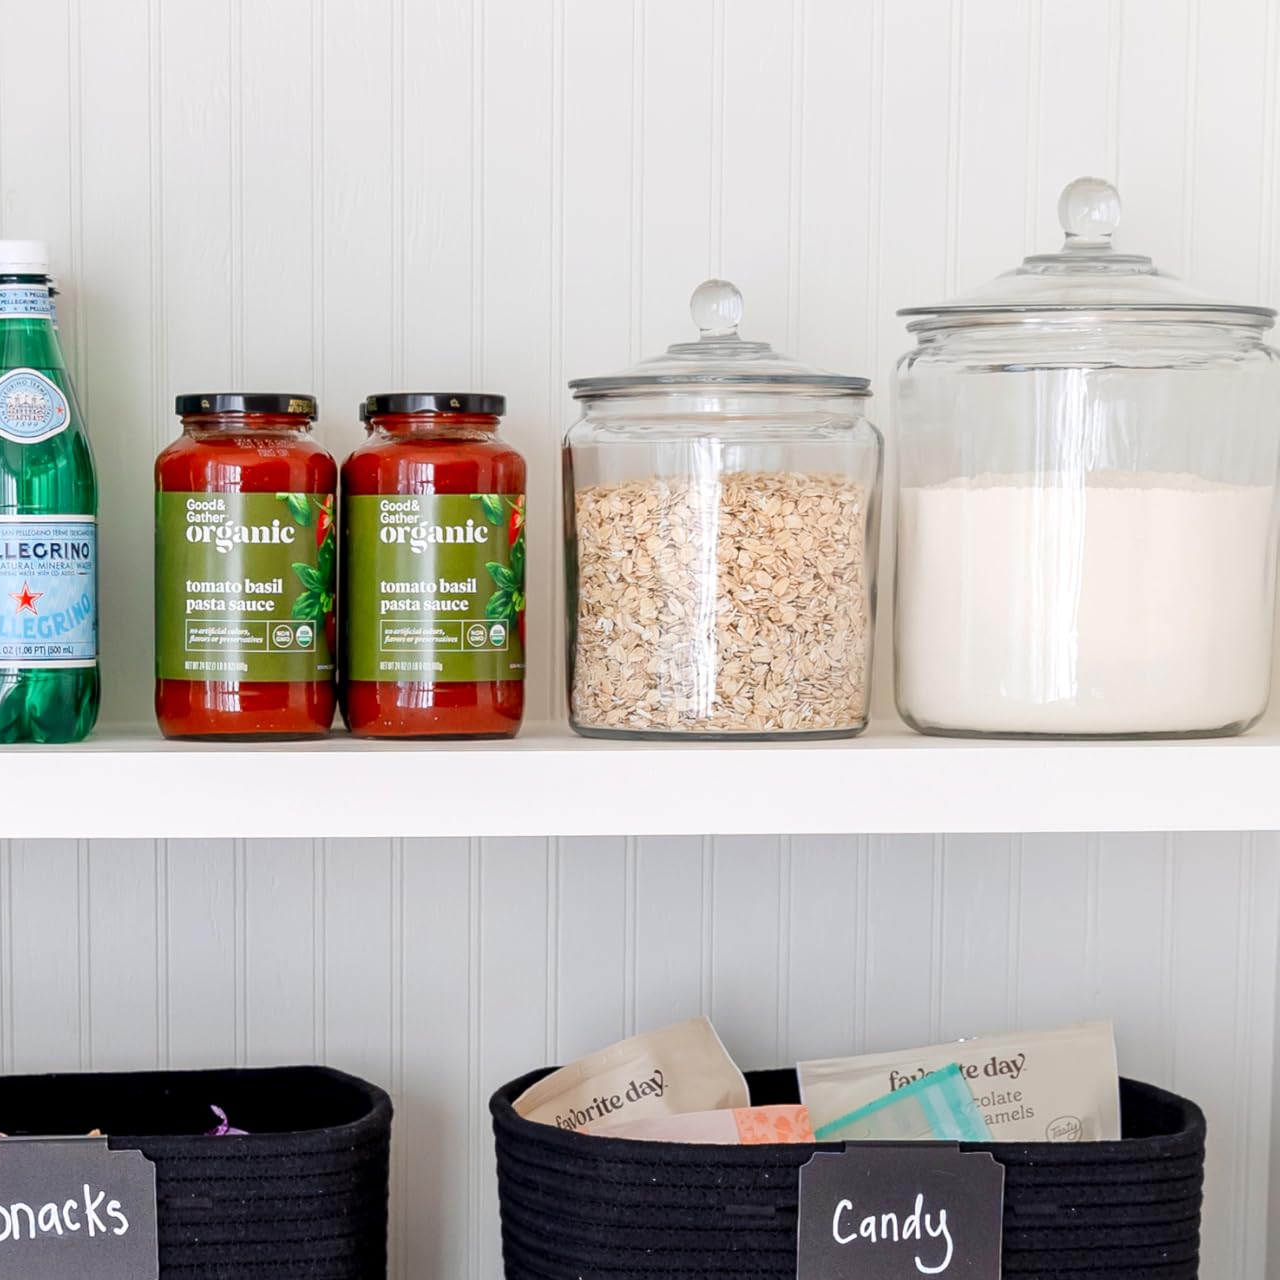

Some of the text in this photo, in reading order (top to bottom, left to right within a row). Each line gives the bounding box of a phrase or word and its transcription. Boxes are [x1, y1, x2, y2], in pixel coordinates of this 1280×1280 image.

[186, 498, 225, 511] Good&
[380, 499, 420, 513] Good&
[186, 511, 225, 523] Gather
[380, 512, 420, 524] Gather
[185, 519, 295, 553] organic
[380, 519, 488, 553] organic
[38, 562, 74, 570] MINERAL
[186, 578, 283, 594] tomato basil
[380, 578, 477, 594] tomato basil
[186, 598, 275, 614] pasta sauce
[380, 598, 469, 614] pasta sauce
[2, 646, 14, 655] OZ
[555, 1094, 624, 1131] favorite
[833, 1193, 954, 1274] Candy
